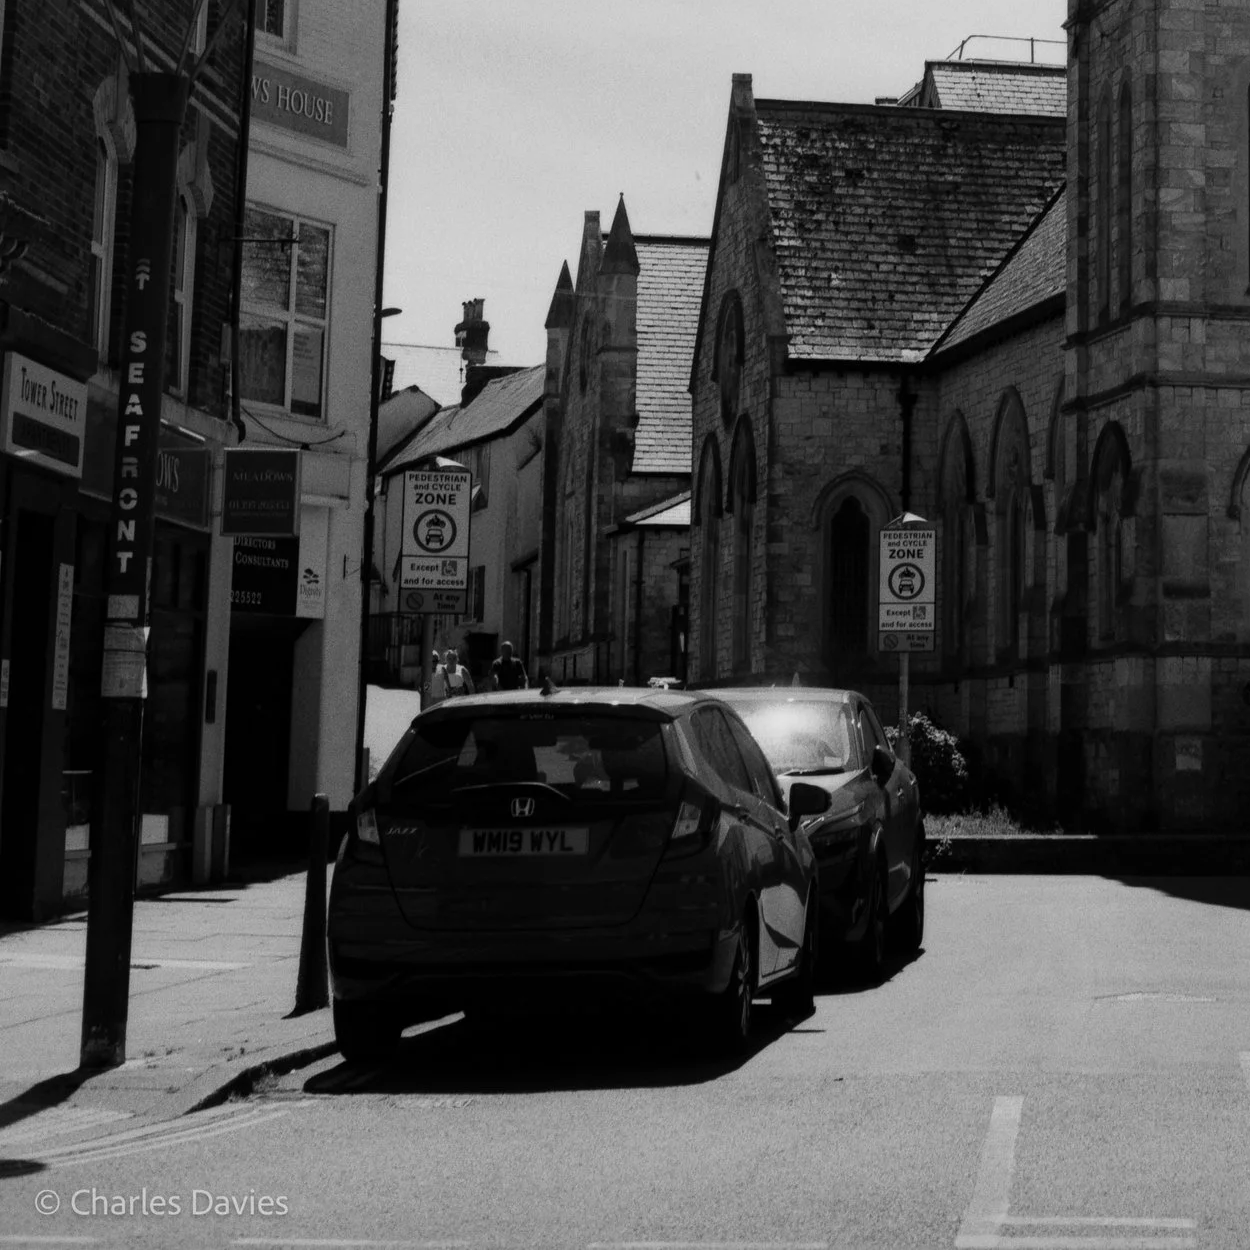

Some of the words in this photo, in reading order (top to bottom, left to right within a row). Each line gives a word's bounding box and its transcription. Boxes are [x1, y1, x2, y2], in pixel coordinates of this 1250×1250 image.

[277, 85, 333, 125] HOUSE
[21, 367, 47, 411] TOWER
[50, 380, 78, 422] STREET
[117, 331, 147, 574] SEAFRONT
[233, 472, 293, 482] MEADOWS
[409, 473, 467, 483] PEDESTRIAN
[414, 483, 430, 491] and
[432, 483, 461, 491] CYCLE
[415, 493, 456, 505] ZONE
[234, 535, 276, 550] DIRECTORS
[889, 549, 924, 559] ZONE
[235, 551, 289, 568] CONSULTANTS
[410, 563, 439, 572] Except
[404, 577, 419, 585] and
[422, 577, 434, 585] for
[436, 578, 464, 586] access
[433, 593, 444, 601] At
[445, 594, 460, 603] any
[437, 602, 455, 610] time
[886, 609, 911, 617] Except
[916, 635, 929, 643] any
[472, 830, 523, 853] WM19
[530, 830, 574, 853] WYL
